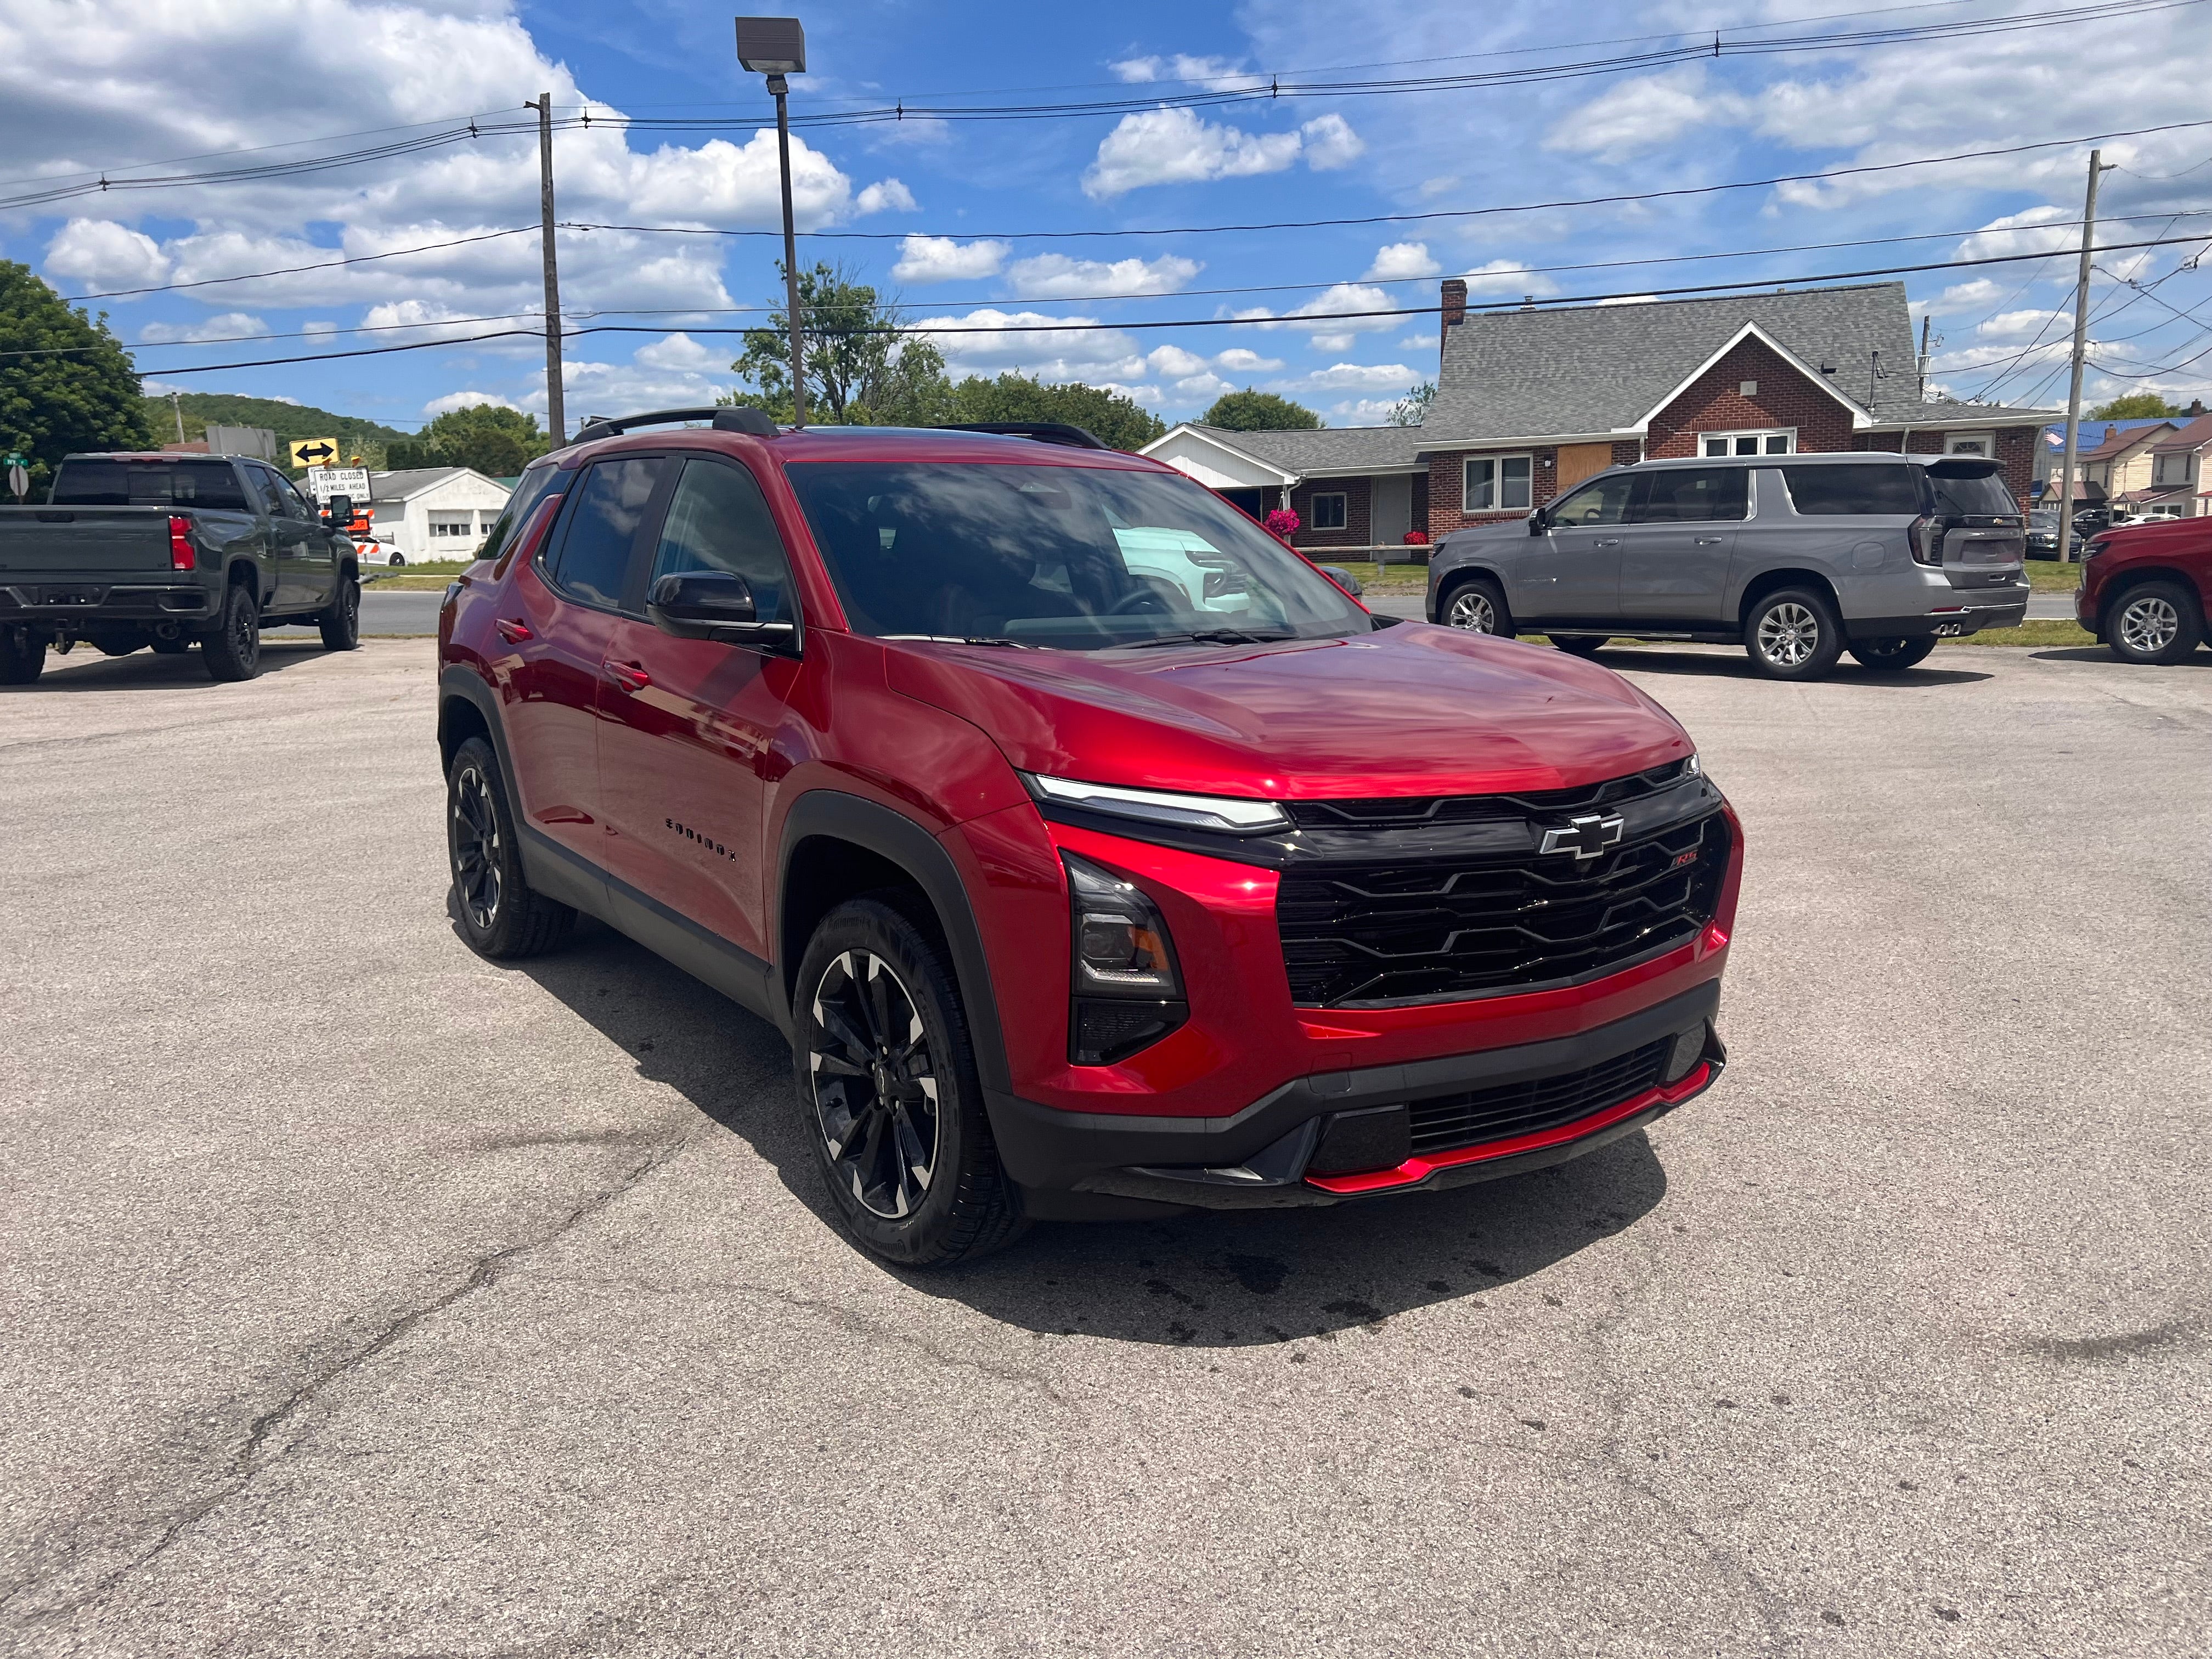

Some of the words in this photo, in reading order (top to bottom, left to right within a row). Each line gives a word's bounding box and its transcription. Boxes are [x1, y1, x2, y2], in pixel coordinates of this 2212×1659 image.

[320, 473, 336, 481] ROAD
[320, 483, 330, 493] 1/2
[665, 818, 736, 862] EQUINOX
[1677, 851, 1697, 866] RS
